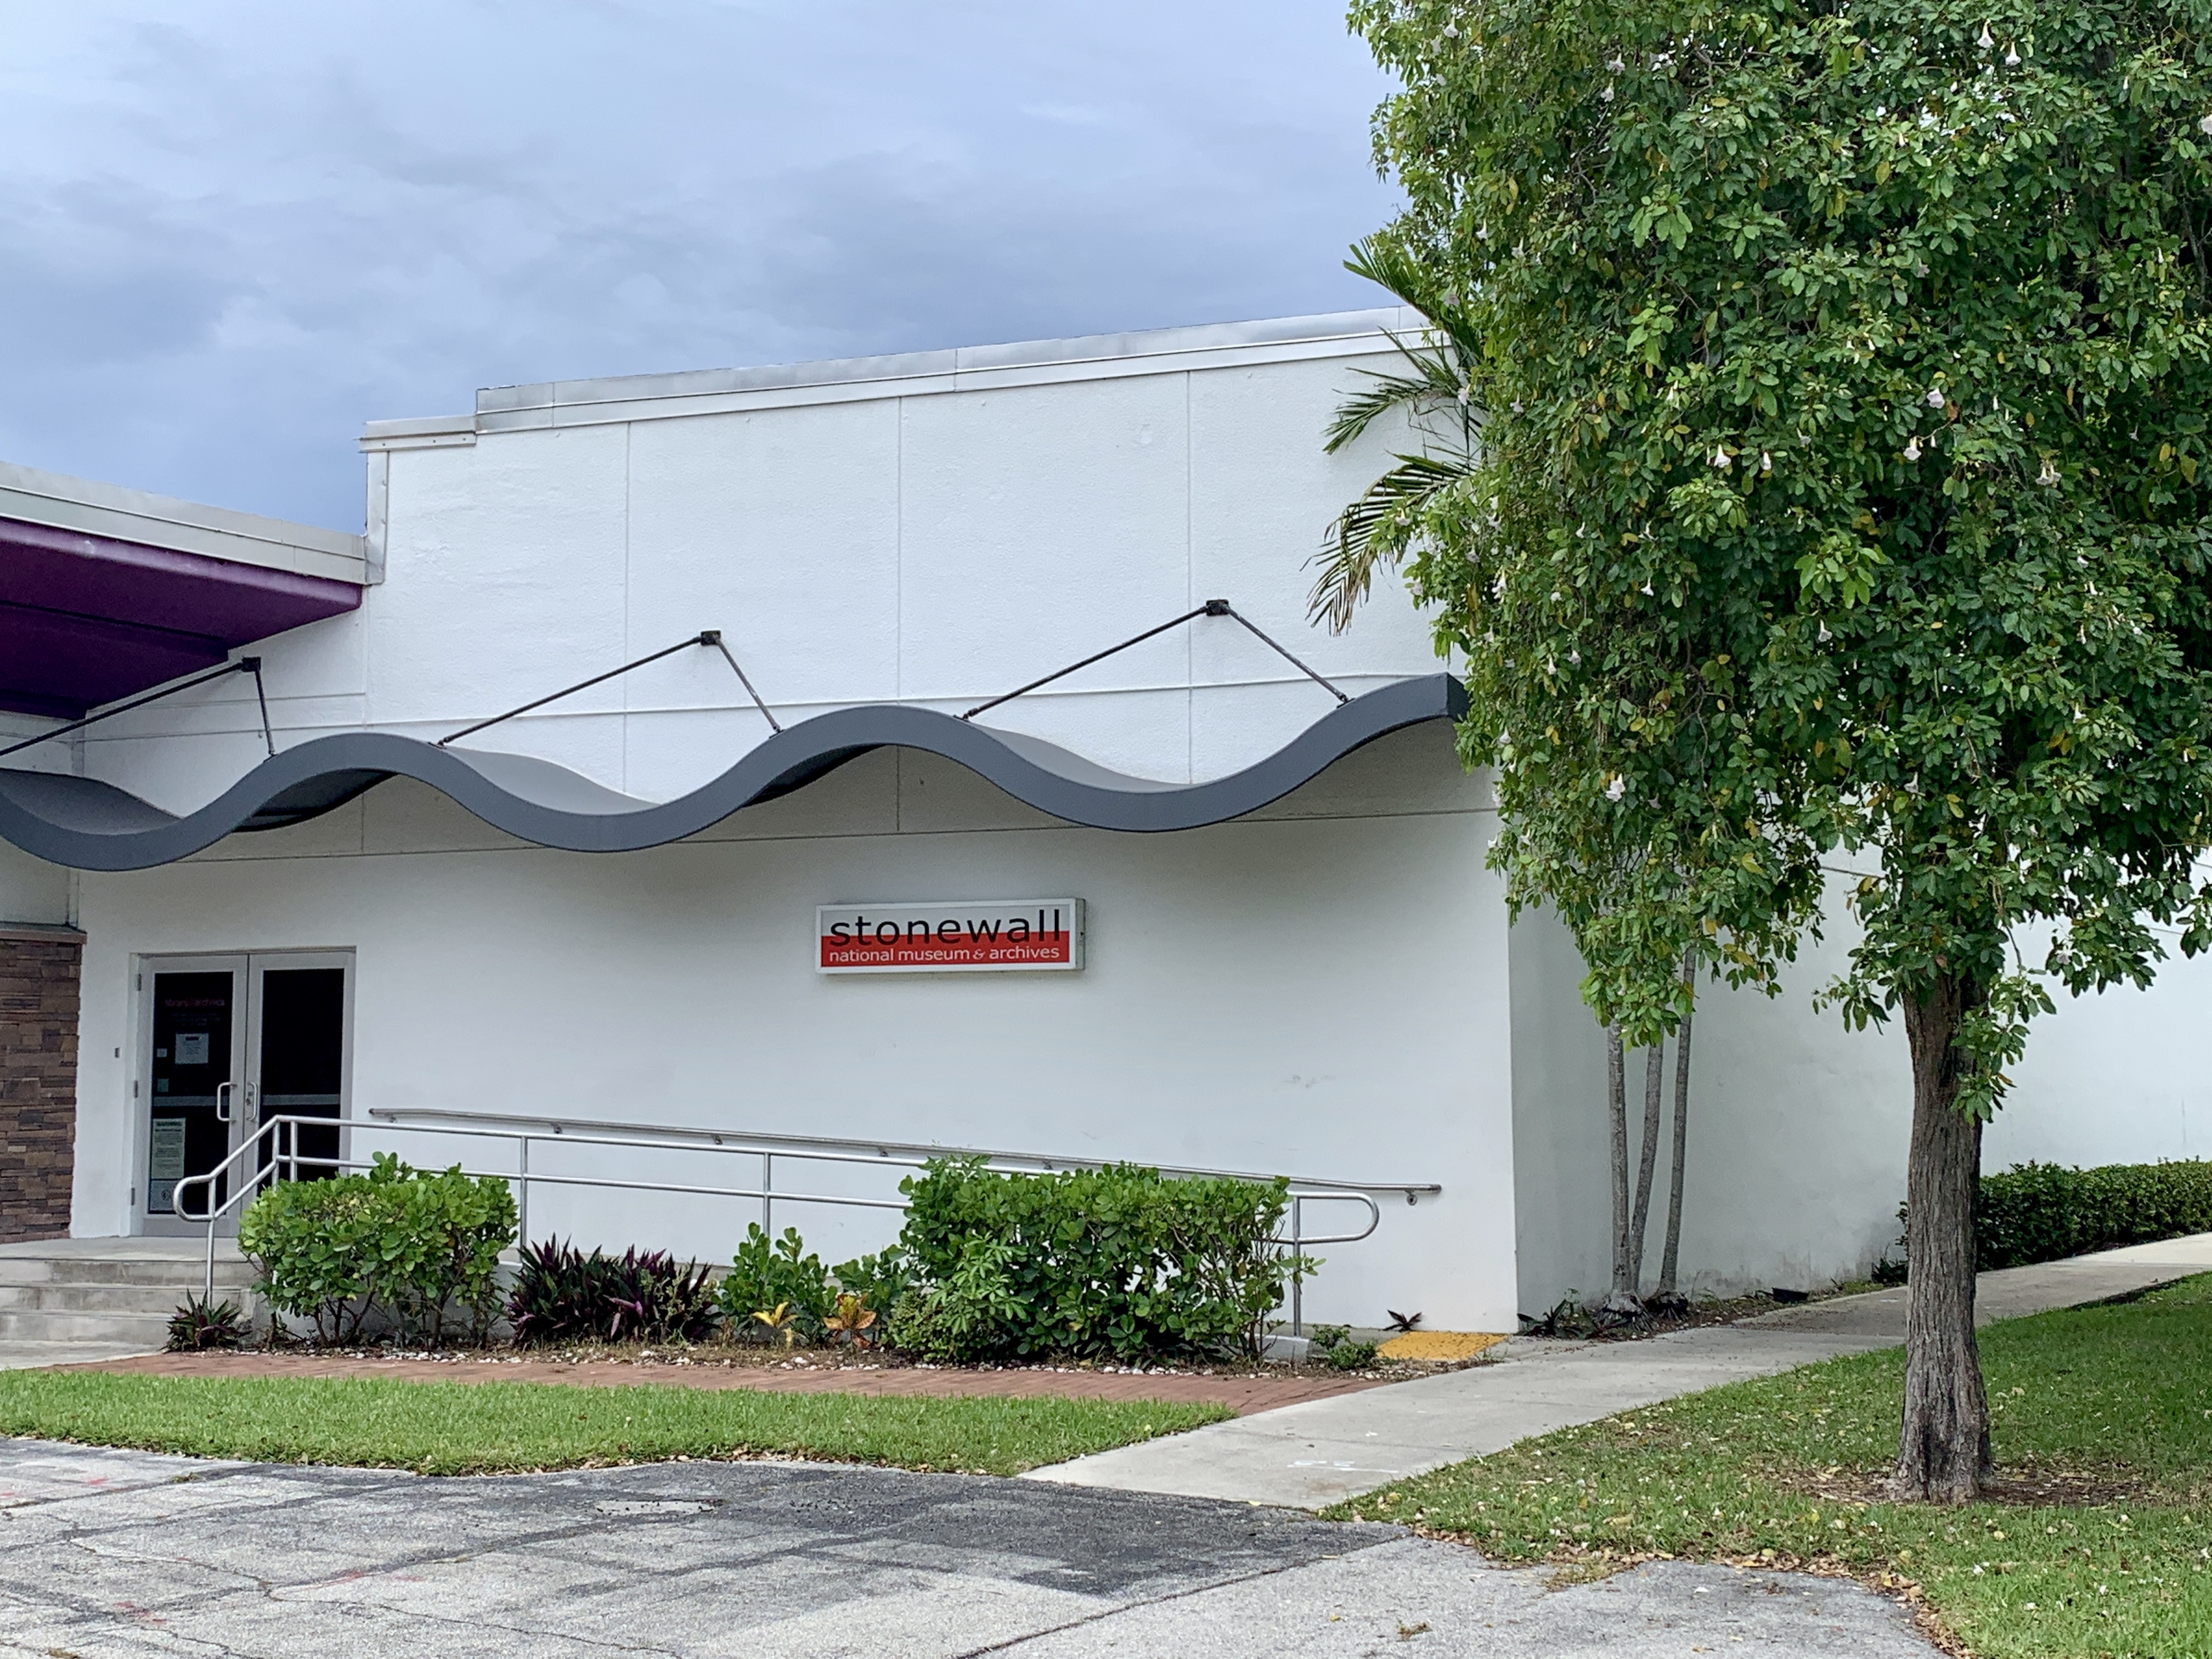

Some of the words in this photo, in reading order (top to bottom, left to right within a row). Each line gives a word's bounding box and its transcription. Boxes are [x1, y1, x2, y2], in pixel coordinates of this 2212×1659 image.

[830, 909, 1060, 947] stonewall
[830, 948, 894, 962] national
[899, 950, 970, 961] museum
[973, 950, 985, 960] &
[989, 945, 1060, 960] archives
